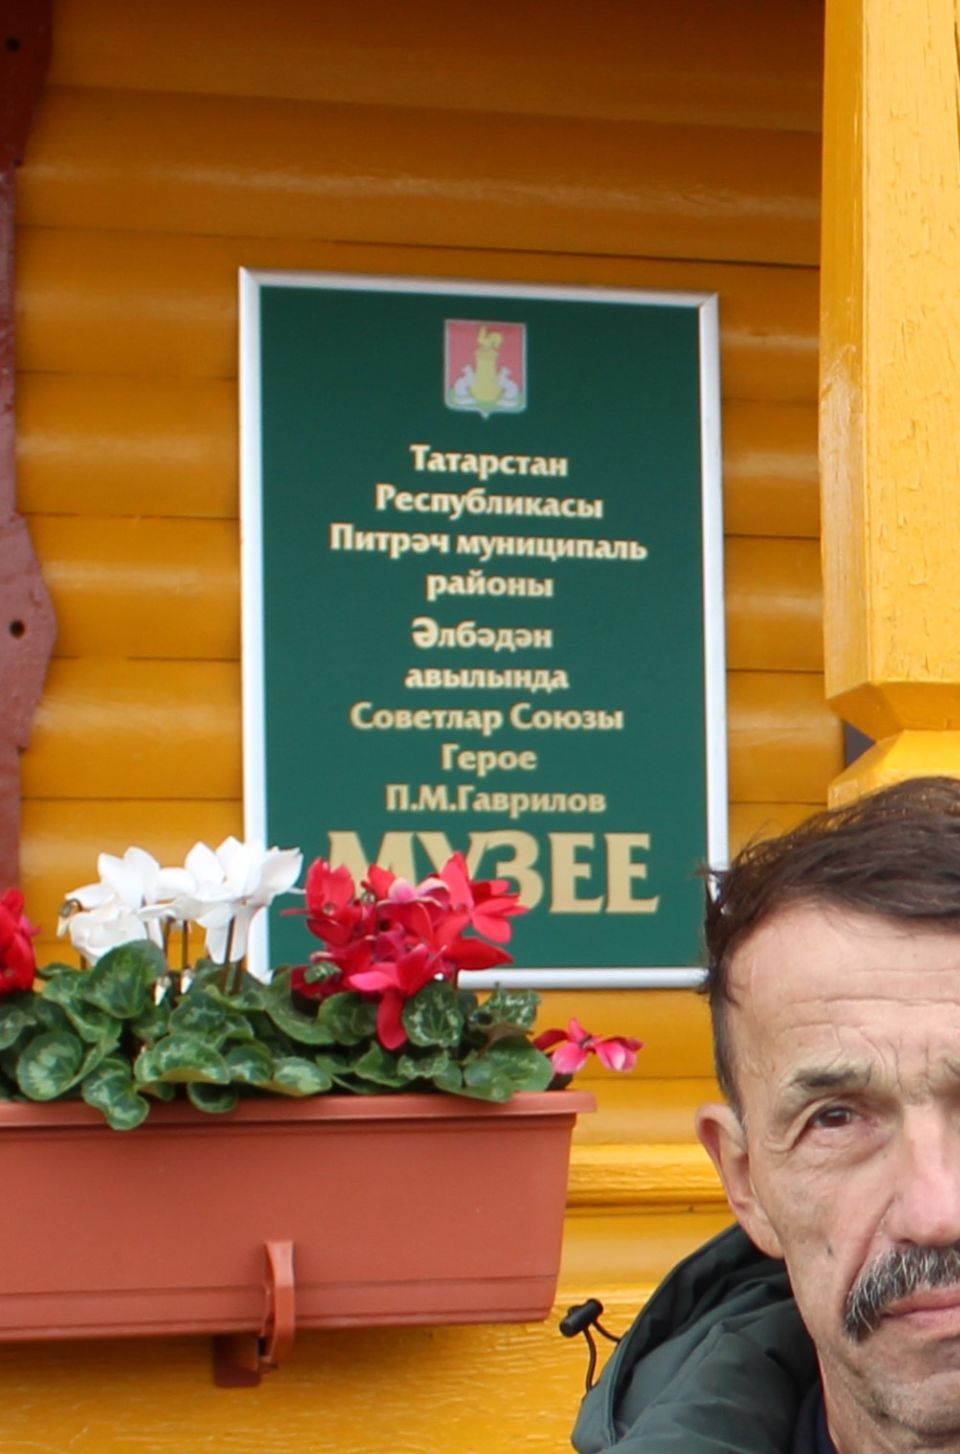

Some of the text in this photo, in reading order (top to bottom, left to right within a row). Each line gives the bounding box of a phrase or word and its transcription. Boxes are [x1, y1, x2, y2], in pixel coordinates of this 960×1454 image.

[409, 444, 569, 481] Татарстан
[374, 483, 603, 520] Республикасы
[329, 522, 649, 562] Питрәч муниципаль
[425, 568, 554, 602] районы
[411, 616, 554, 653] Әлбәдән
[404, 666, 570, 693] авылында
[349, 701, 624, 737] Советлар Союзы
[440, 743, 538, 778] Герое
[385, 784, 606, 820] П.М.Гаврилов
